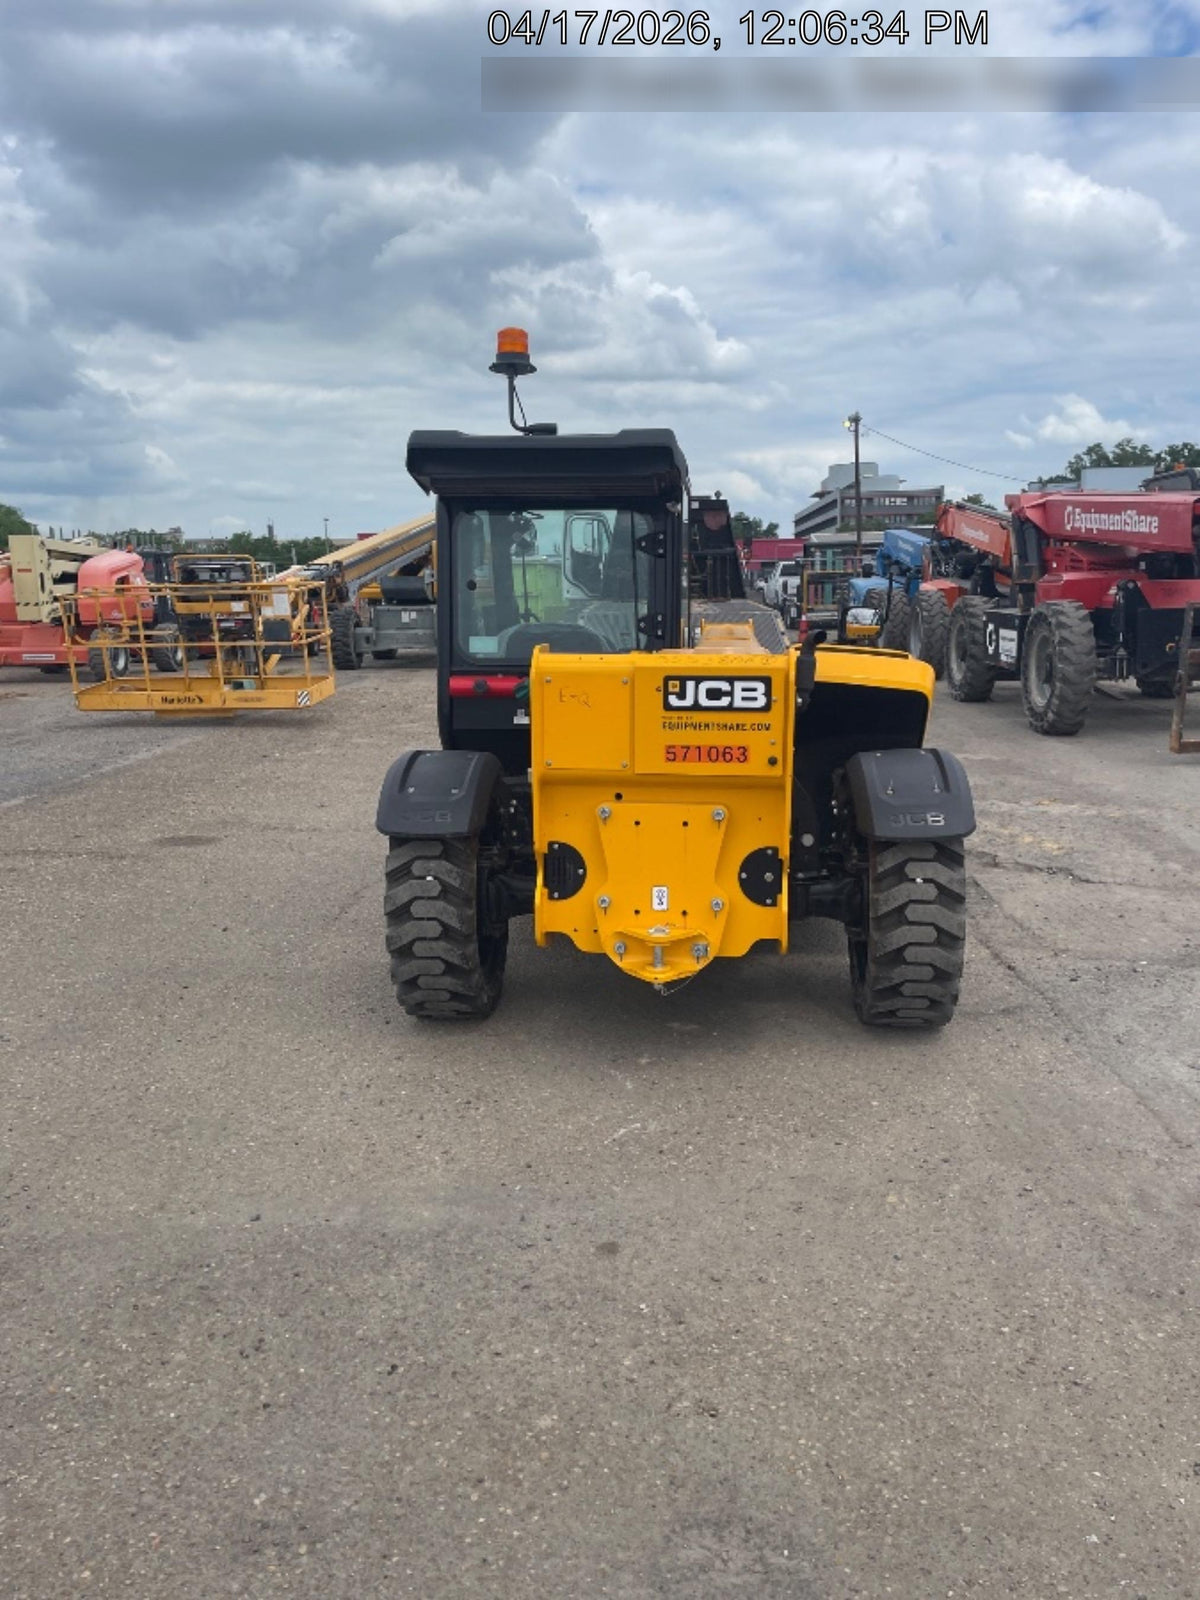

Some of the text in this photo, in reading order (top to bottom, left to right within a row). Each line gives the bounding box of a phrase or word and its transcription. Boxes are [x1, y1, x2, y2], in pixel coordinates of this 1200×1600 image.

[1074, 507, 1159, 534] EquipmentShare
[668, 680, 767, 708] JCB
[665, 745, 748, 763] 571063
